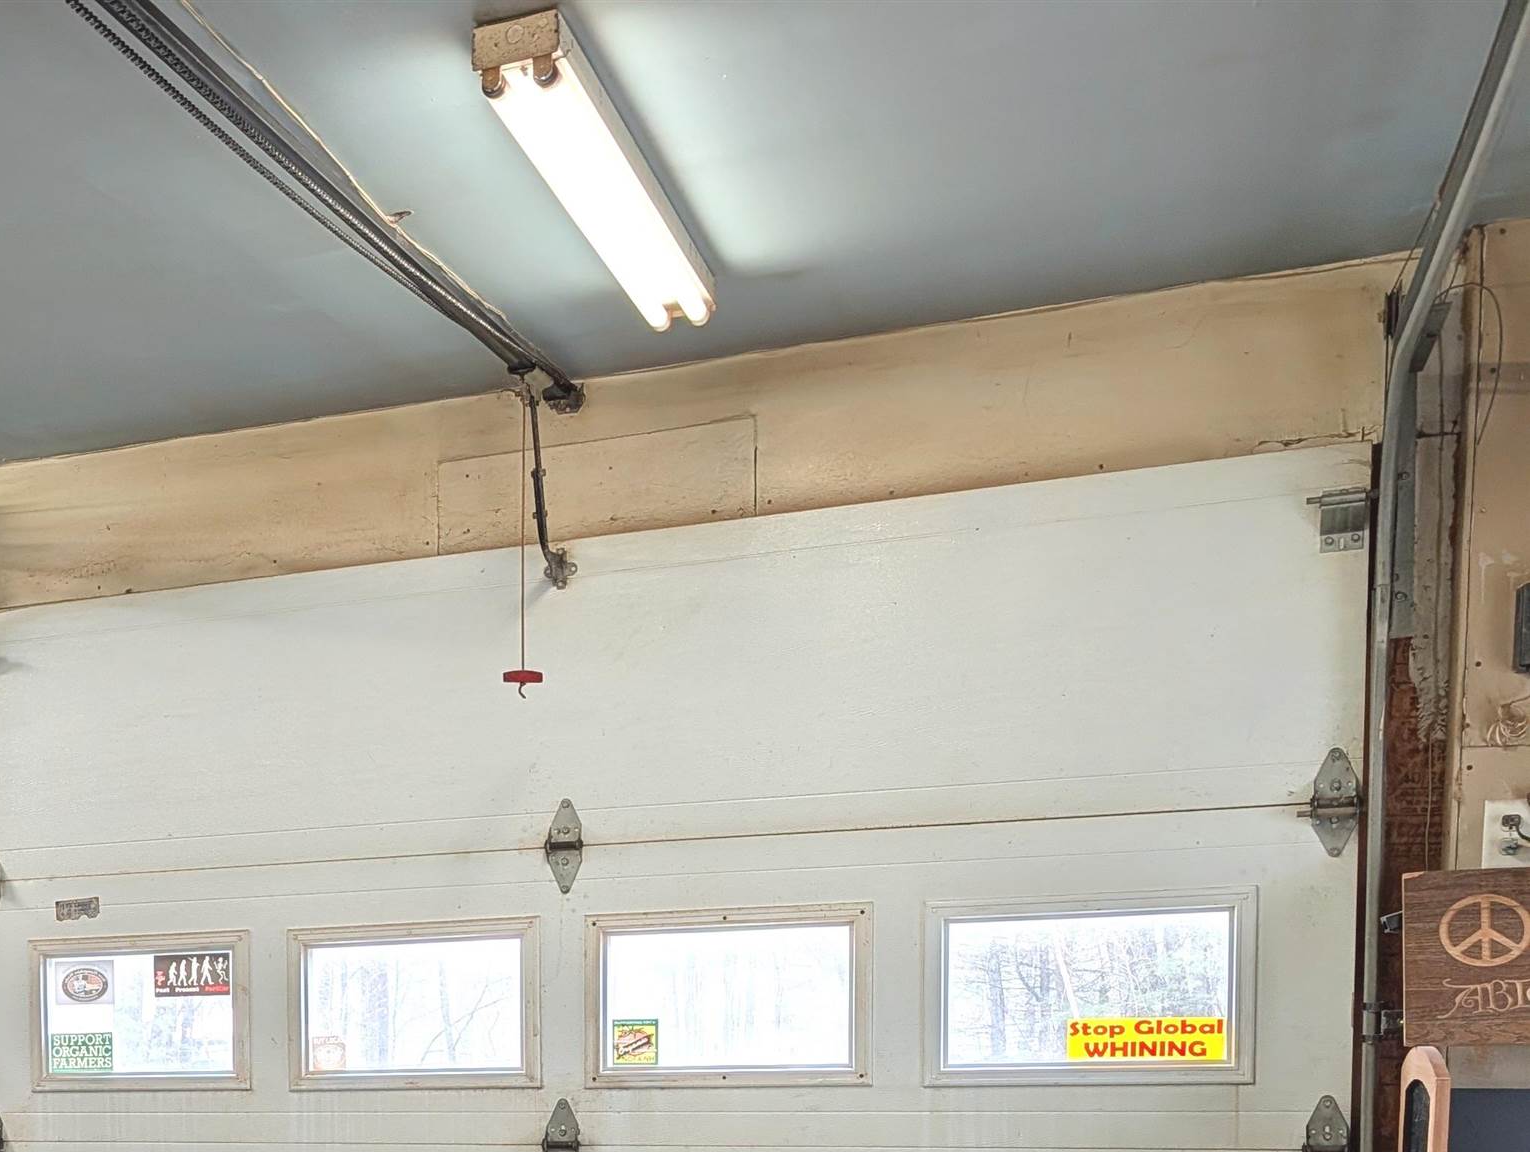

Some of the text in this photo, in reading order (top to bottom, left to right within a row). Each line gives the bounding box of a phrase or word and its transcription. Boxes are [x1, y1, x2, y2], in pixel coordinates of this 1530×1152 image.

[1436, 977, 1530, 1020] ABI
[1069, 1019, 1224, 1038] Stop Global
[53, 1033, 112, 1046] SUPPORT
[52, 1045, 112, 1058] ORGANIC
[1083, 1040, 1207, 1058] WHINING
[53, 1057, 112, 1069] FARMERS
